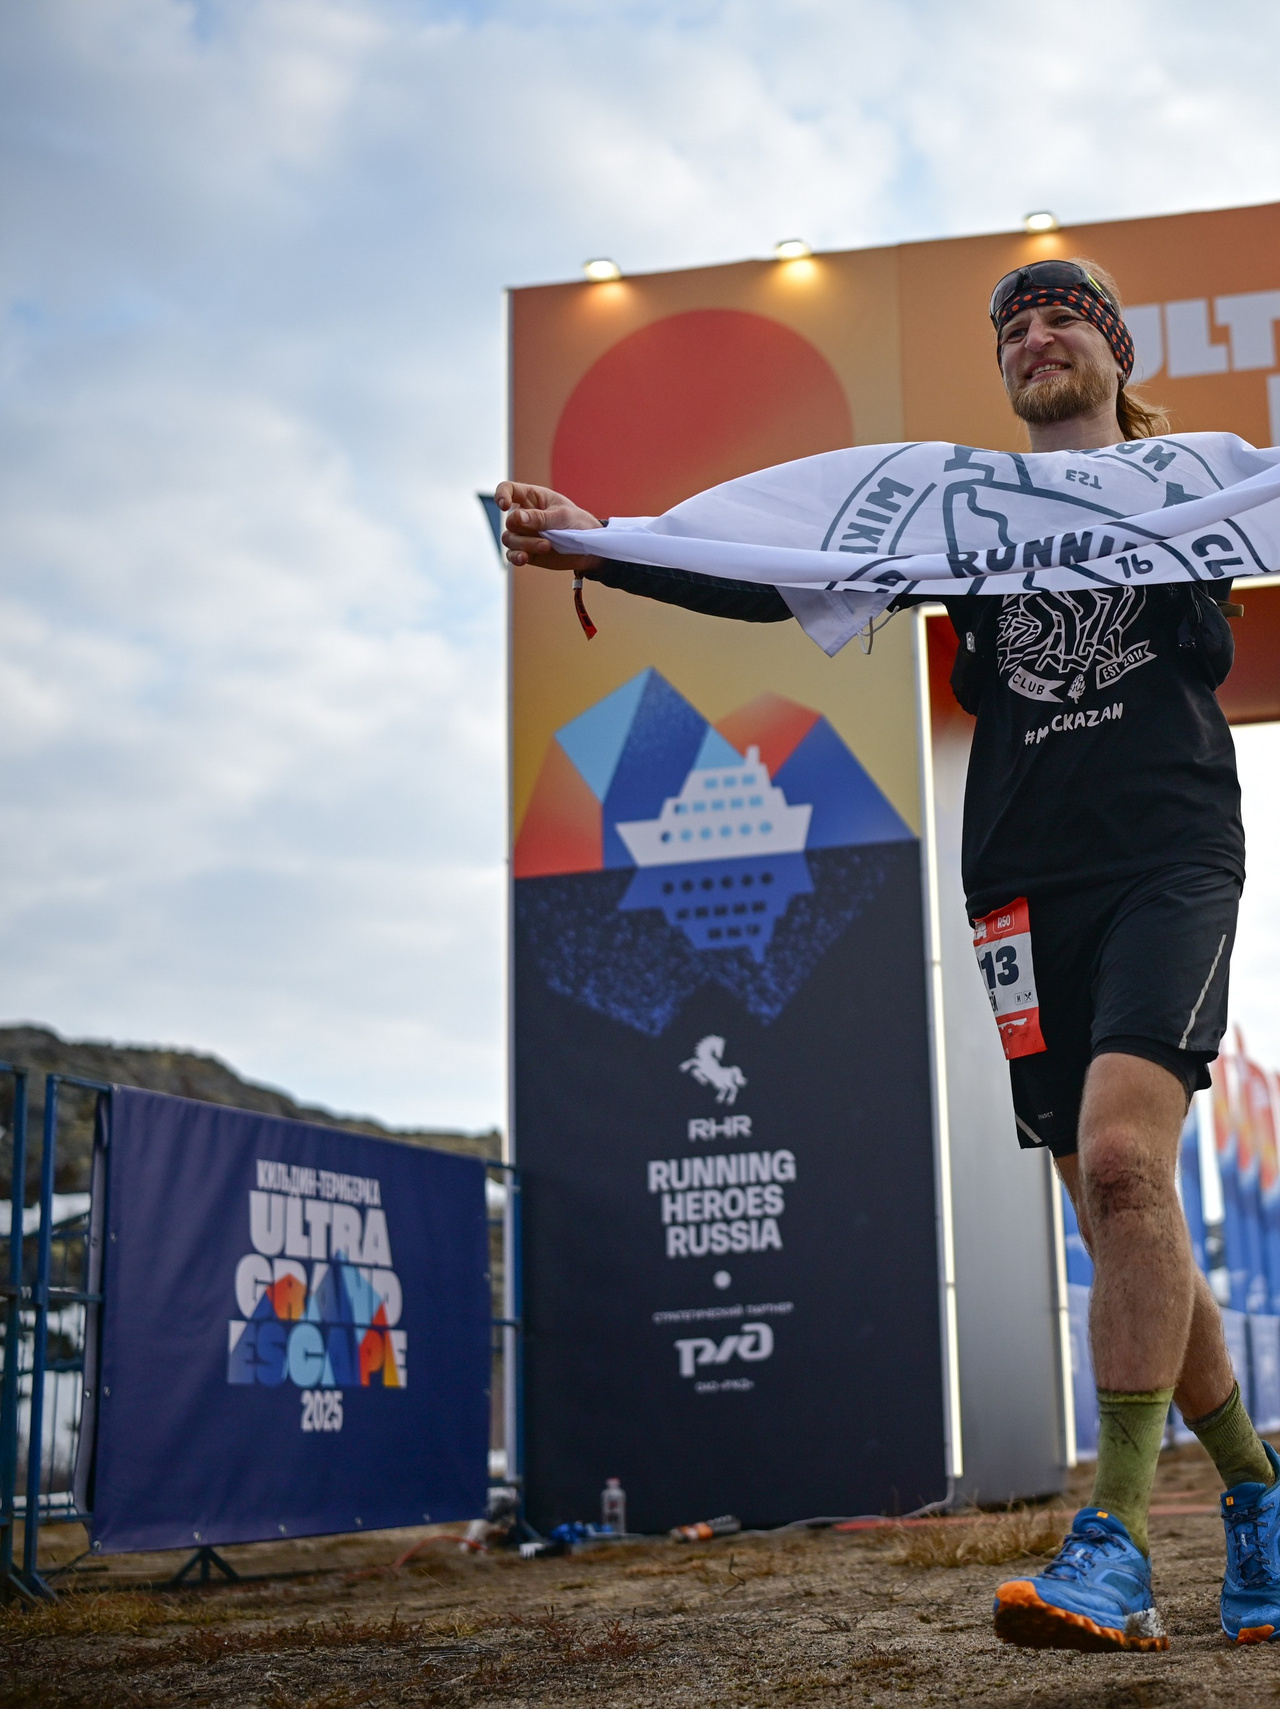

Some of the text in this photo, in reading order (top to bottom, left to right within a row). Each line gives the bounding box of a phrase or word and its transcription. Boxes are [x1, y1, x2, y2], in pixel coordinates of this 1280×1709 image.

[1115, 553, 1154, 579] 16
[1191, 534, 1254, 580] CL
[1012, 673, 1046, 696] CLUB
[1102, 662, 1121, 681] EST
[1024, 702, 1124, 746] #MCKAZAN
[998, 914, 1011, 929] R50
[977, 945, 1020, 990] 13
[688, 1114, 752, 1141] RHR
[648, 1149, 796, 1193] RUNNING
[662, 1184, 784, 1225] HEROES
[249, 1189, 393, 1268] ULTRA
[667, 1218, 782, 1258] RUSSIA
[235, 1253, 403, 1329] GRAND
[227, 1319, 407, 1389] ESCAPE
[301, 1389, 343, 1432] 2025
